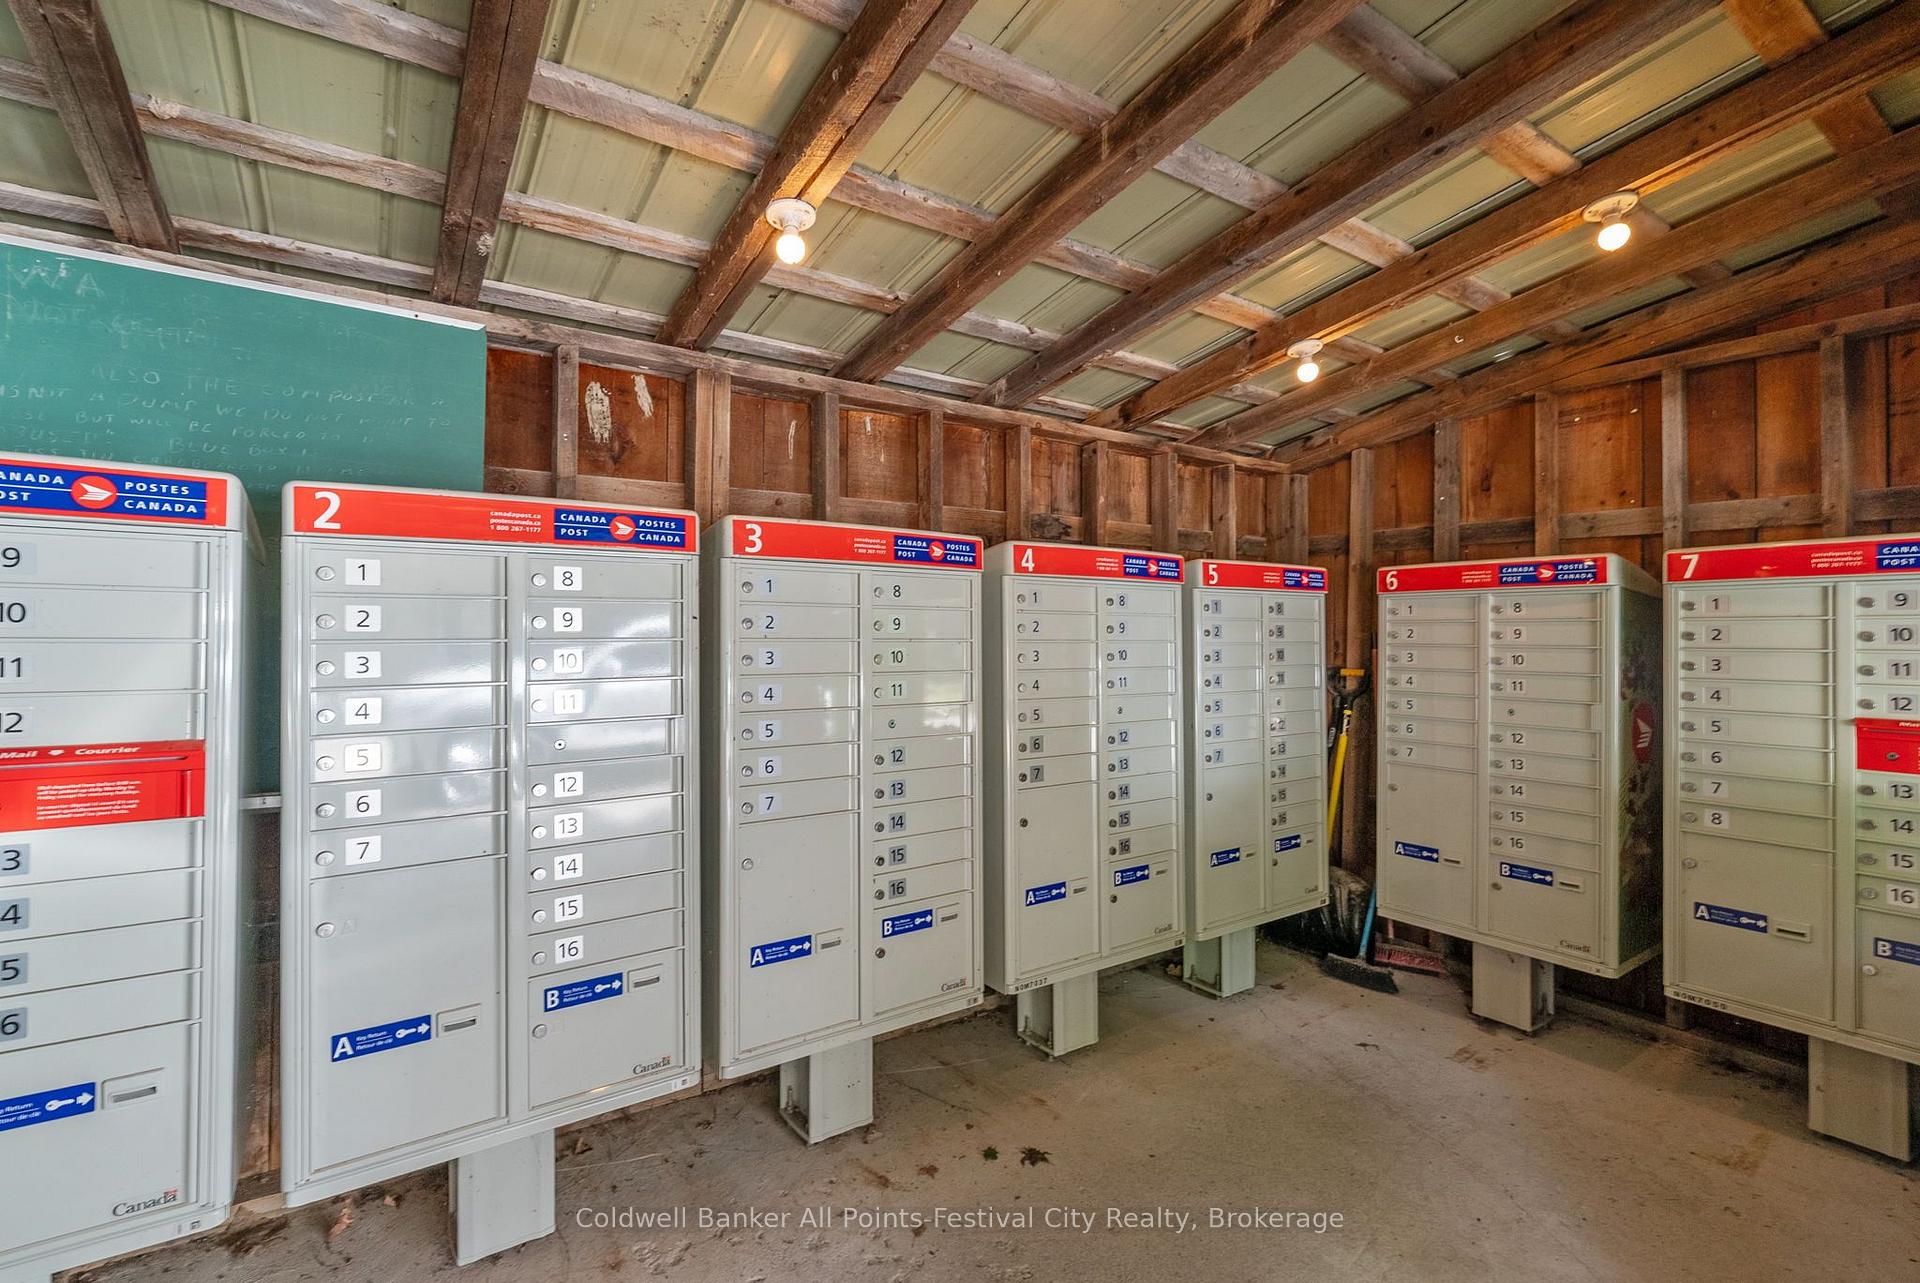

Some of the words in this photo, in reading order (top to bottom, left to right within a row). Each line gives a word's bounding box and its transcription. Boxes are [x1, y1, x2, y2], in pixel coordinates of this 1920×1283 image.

[185, 369, 239, 395] THE
[76, 412, 114, 424] BUT
[124, 481, 190, 496] POSTES
[124, 499, 198, 514] CANADA
[313, 491, 341, 530] 2
[489, 510, 542, 520] canadapost.ca
[560, 513, 607, 524] CANADA
[639, 519, 676, 529] POSTES
[560, 527, 589, 537] POST
[639, 533, 681, 543] CANADA
[744, 523, 763, 553] 3
[897, 539, 927, 547] CANADA
[2, 547, 21, 568] 9
[1021, 548, 1035, 572] 4
[1883, 558, 1916, 566] POST
[357, 563, 366, 581] 1
[1681, 554, 1699, 579] 7
[562, 570, 574, 587] 8
[1208, 564, 1218, 585] 5
[1386, 570, 1399, 591] 6
[766, 579, 772, 593] 1
[893, 585, 901, 598] 8
[1033, 592, 1038, 603] 1
[1119, 595, 1125, 606] 8
[1711, 597, 1719, 610] 1
[1894, 592, 1908, 607] 9
[1407, 605, 1413, 615] 1
[1513, 602, 1522, 614] 8
[356, 609, 370, 628] 2
[562, 611, 574, 628] 9
[765, 616, 775, 629] 2
[892, 617, 901, 631] 9
[1032, 620, 1040, 633] 2
[1119, 622, 1125, 633] 9
[1214, 627, 1220, 637] 2
[1407, 628, 1414, 639] 2
[1513, 628, 1522, 640] 9
[1711, 628, 1722, 641] 2
[1890, 627, 1913, 642] 10
[558, 652, 577, 669] 10
[765, 651, 774, 665] 3
[890, 651, 903, 664] 10
[1032, 650, 1040, 662] 3
[1118, 650, 1127, 661] 10
[1214, 651, 1220, 662] 3
[1407, 652, 1414, 663] 3
[1511, 654, 1525, 666] 10
[356, 656, 370, 674] 3
[1711, 658, 1721, 671] 3
[1891, 662, 1911, 677] 11
[1032, 680, 1040, 691] 4
[1119, 677, 1127, 687] 11
[1214, 676, 1220, 686] 4
[1406, 676, 1414, 686] 4
[1511, 680, 1524, 692] 11
[764, 687, 773, 701] 4
[891, 683, 902, 696] 11
[1710, 690, 1721, 702] 4
[560, 694, 576, 710] 11
[1215, 701, 1220, 712] 5
[1406, 700, 1413, 710] 5
[1890, 696, 1912, 711] 12
[354, 703, 370, 720] 4
[1033, 709, 1040, 720] 5
[765, 724, 774, 738] 5
[1215, 726, 1221, 736] 6
[1406, 723, 1414, 734] 6
[1711, 720, 1722, 733] 5
[1119, 731, 1128, 743] 12
[1510, 733, 1524, 744] 12
[1033, 738, 1040, 750] 6
[0, 749, 39, 760] Mail
[75, 746, 141, 756] Courrier
[357, 748, 369, 766] 5
[890, 749, 903, 763] 12
[1215, 751, 1222, 762] 7
[1406, 747, 1413, 758] 7
[1711, 750, 1722, 763] 6
[764, 760, 774, 774] 6
[1119, 758, 1128, 770] 13
[1510, 759, 1524, 771] 13
[1033, 768, 1040, 780] 7
[559, 776, 577, 793] 12
[890, 783, 904, 796] 13
[1510, 785, 1524, 797] 14
[1711, 781, 1722, 793] 7
[1119, 786, 1128, 798] 14
[1890, 784, 1913, 799] 13
[356, 795, 370, 813] 6
[764, 797, 774, 811] 7
[890, 815, 904, 829] 14
[1119, 813, 1130, 824] 15
[1510, 811, 1524, 823] 15
[1711, 812, 1722, 825] 8
[558, 817, 578, 834] 13
[1890, 818, 1914, 834] 14
[1119, 840, 1130, 852] 16
[1396, 844, 1405, 855] A
[1509, 837, 1524, 849] 16
[356, 841, 370, 860] 7
[890, 848, 904, 862] 15
[557, 858, 578, 876] 14
[1890, 853, 1914, 869] 15
[1501, 864, 1510, 877] B
[1115, 872, 1122, 885] B
[890, 882, 904, 895] 16
[1026, 890, 1036, 904] A
[1890, 888, 1914, 905] 16
[558, 899, 578, 917] 15
[1696, 904, 1710, 920] A
[883, 920, 892, 936] B
[558, 940, 579, 959] 16
[1877, 940, 1892, 957] B
[751, 949, 764, 966] A
[546, 989, 559, 1009] B
[333, 1036, 354, 1059] A
[633, 1057, 671, 1076] Canada
[112, 1191, 178, 1218] Canada
